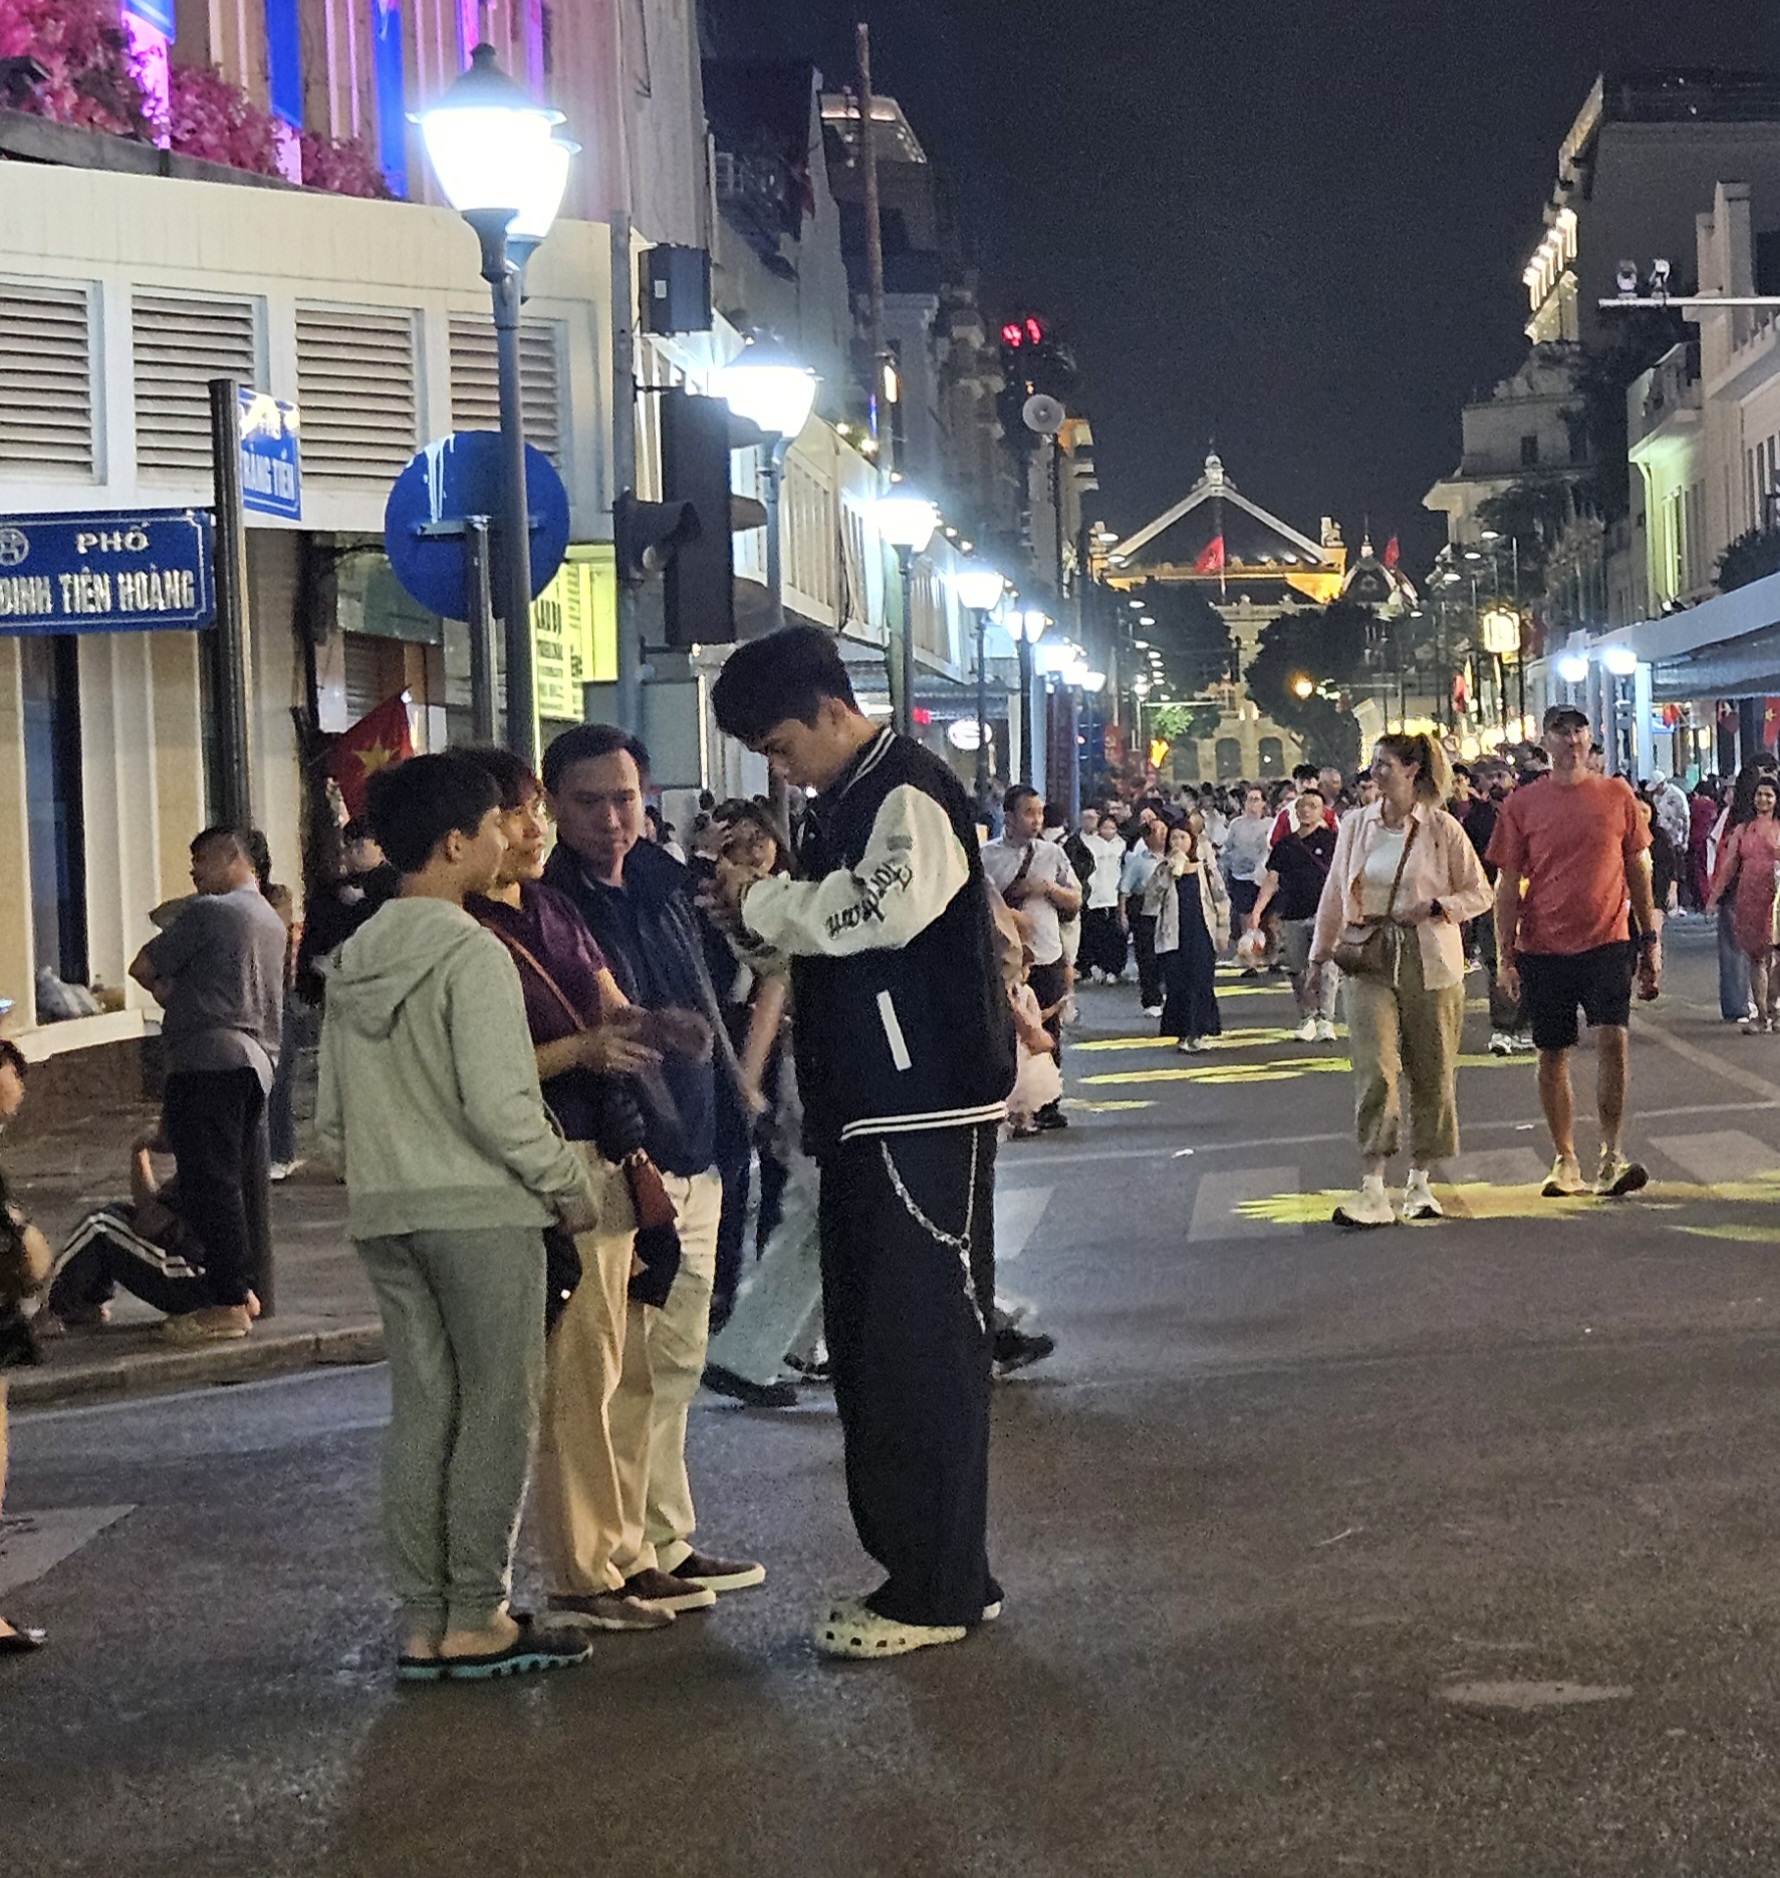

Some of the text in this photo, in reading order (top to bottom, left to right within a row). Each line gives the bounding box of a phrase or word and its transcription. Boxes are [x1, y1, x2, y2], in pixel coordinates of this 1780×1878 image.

[76, 520, 150, 554] PHỐ
[58, 565, 111, 614] TIÊN
[117, 562, 196, 612] HOÀNG
